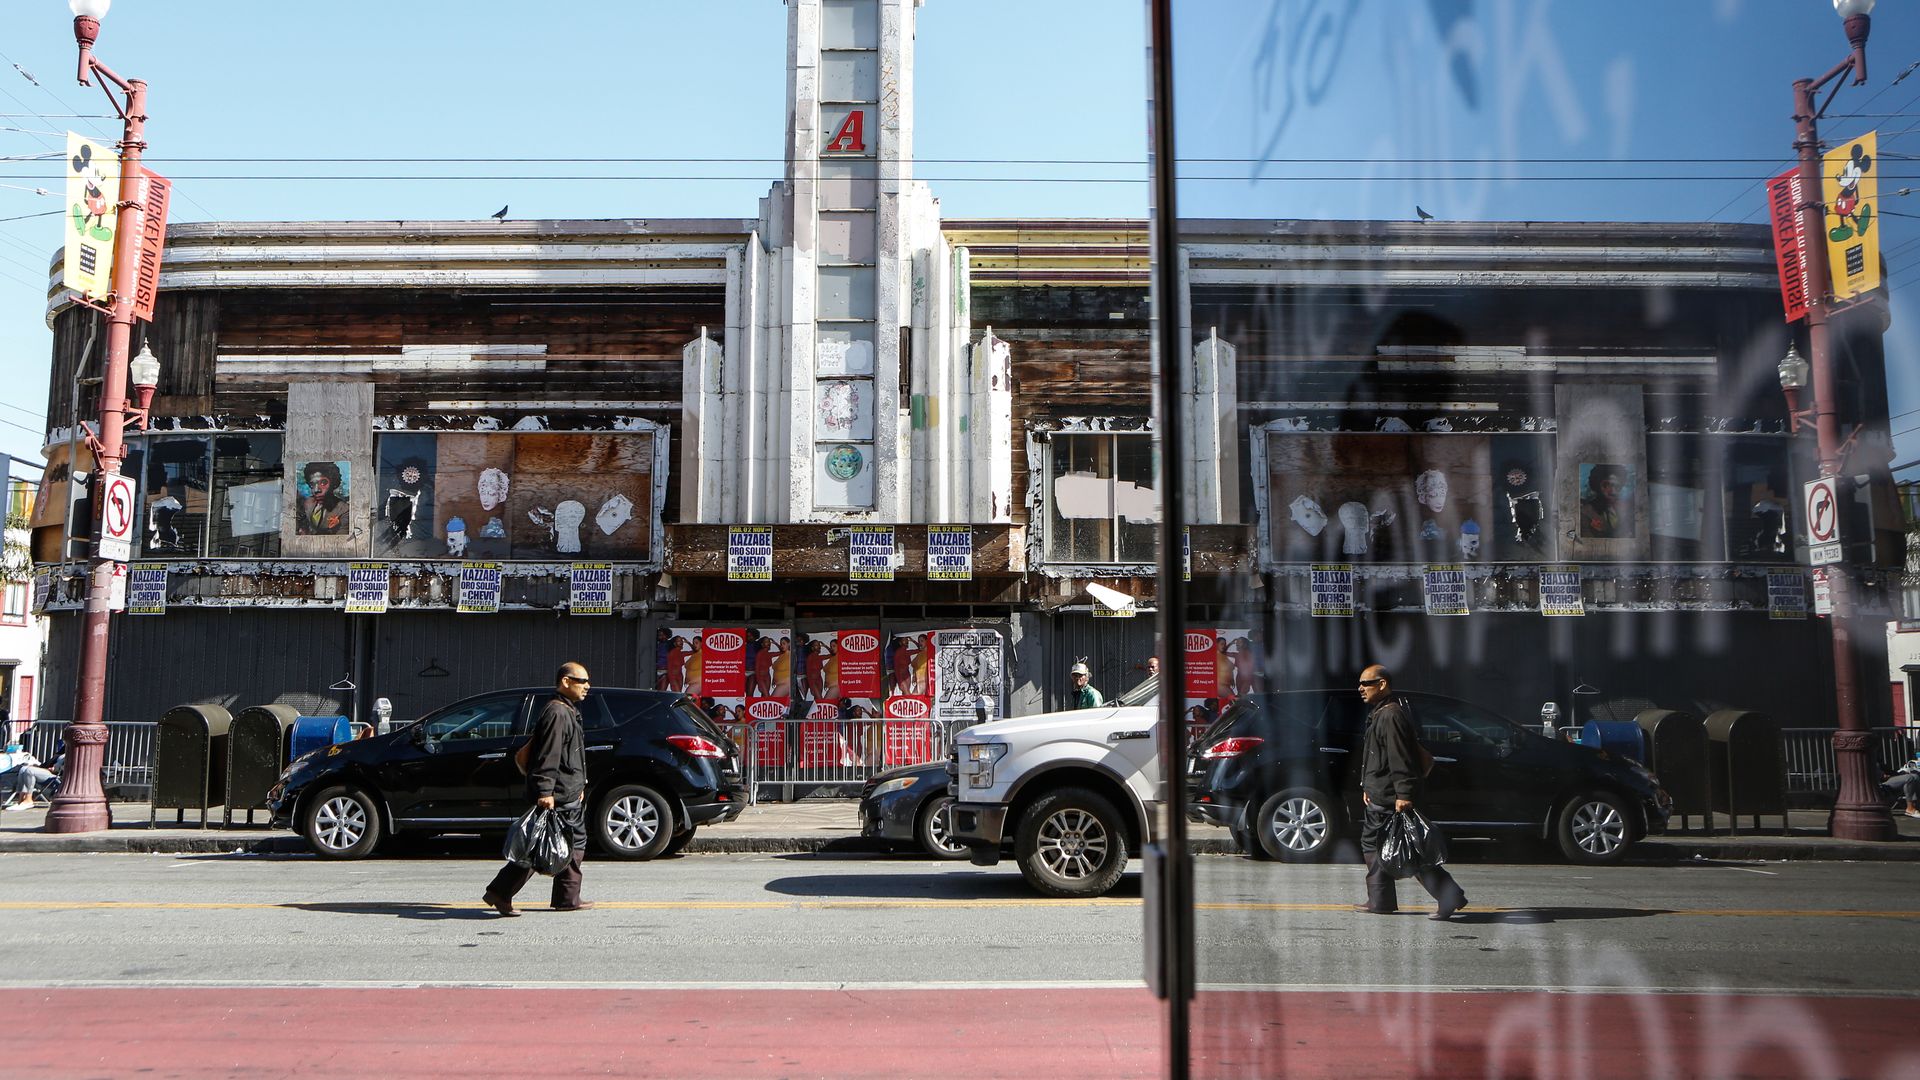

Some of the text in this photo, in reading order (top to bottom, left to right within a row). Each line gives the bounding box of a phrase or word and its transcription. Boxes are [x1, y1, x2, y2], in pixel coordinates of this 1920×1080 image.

[827, 111, 865, 151] A
[136, 180, 166, 312] MICKEY MOUSE
[731, 534, 770, 546] KAZZABE
[853, 534, 892, 546] KAZZABE
[930, 534, 970, 546] KAZZABE
[730, 547, 771, 555] ORO SOLIDO
[851, 547, 893, 555] ORO SOLIDO
[929, 547, 970, 555] ORO SOLIDO
[737, 556, 766, 566] CHEVO
[862, 556, 888, 566] CHEVO
[937, 556, 965, 566] CHEVO
[133, 570, 166, 582] KAZZABE
[350, 570, 387, 582] KAZZABE
[462, 569, 501, 584] KAZZABE
[573, 570, 611, 582] KAZZABE
[144, 583, 165, 591] SOLIDO
[349, 583, 388, 591] ORO SOLIDO
[461, 582, 501, 593] ORO SOLIDO
[572, 583, 611, 591] ORO SOLIDO
[822, 584, 859, 596] 2205
[137, 592, 160, 601] CHEVO
[356, 591, 383, 601] CHEVO
[468, 591, 495, 600] CHEVO
[579, 592, 606, 601] CHEVO
[709, 634, 740, 649] PARADE
[845, 636, 875, 651] PARADE
[752, 703, 784, 718] PARADE
[892, 701, 923, 716] PARADE
